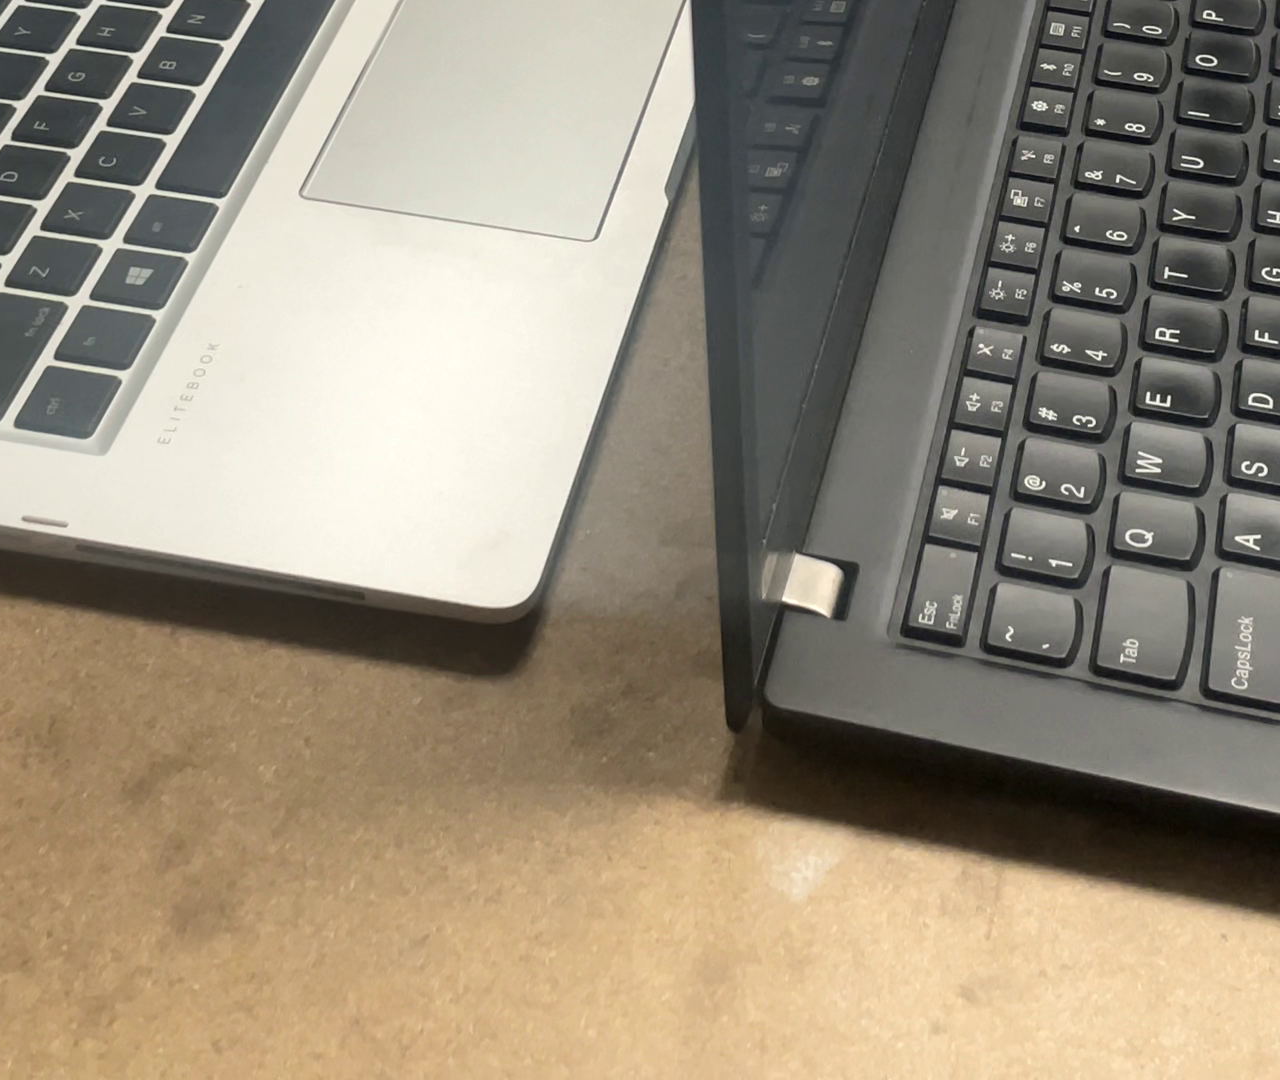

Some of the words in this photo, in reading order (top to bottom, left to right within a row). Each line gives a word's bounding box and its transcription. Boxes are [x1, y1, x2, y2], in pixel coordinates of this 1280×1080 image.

[187, 14, 206, 24] N
[1203, 10, 1224, 21] P
[14, 27, 31, 35] Y
[97, 27, 116, 37] H
[1071, 26, 1083, 38] F11
[1143, 25, 1162, 35] 0
[159, 61, 177, 72] B
[1196, 54, 1218, 67] O
[1062, 64, 1075, 77] F10
[68, 72, 85, 82] G
[1134, 73, 1154, 82] 9
[128, 106, 147, 115] V
[1054, 104, 1066, 114] F9
[33, 121, 49, 130] F
[1125, 123, 1146, 133] 8
[98, 156, 117, 167] C
[1044, 154, 1055, 164] F8
[1180, 156, 1205, 169] U
[0, 171, 18, 182] D
[1116, 175, 1137, 185] 7
[1034, 197, 1046, 207] F7
[64, 209, 84, 220] X
[1172, 209, 1196, 221] Y
[1106, 231, 1128, 241] 6
[1025, 242, 1036, 253] F6
[29, 266, 50, 277] Z
[1164, 267, 1189, 279] T
[1015, 289, 1027, 300] F5
[1095, 287, 1118, 299] 5
[1155, 328, 1181, 343] R
[1255, 330, 1279, 345] F
[1002, 349, 1015, 361] F4
[1085, 349, 1108, 362] 4
[156, 342, 220, 445] ELITEBOOK
[1145, 392, 1172, 407] E
[1248, 393, 1274, 409] D
[991, 401, 1004, 414] F3
[1073, 415, 1097, 427] 3
[980, 455, 993, 468] F2
[1136, 451, 1163, 473] W
[1241, 461, 1269, 477] S
[1061, 484, 1085, 498] 2
[967, 514, 980, 525] F1
[1125, 529, 1154, 548] Q
[1234, 535, 1262, 551] A
[1048, 559, 1073, 567] 1
[919, 601, 938, 625] Esc
[946, 594, 965, 630] FnLock
[1120, 639, 1140, 664] Tab
[1231, 616, 1254, 691] CapsLock
